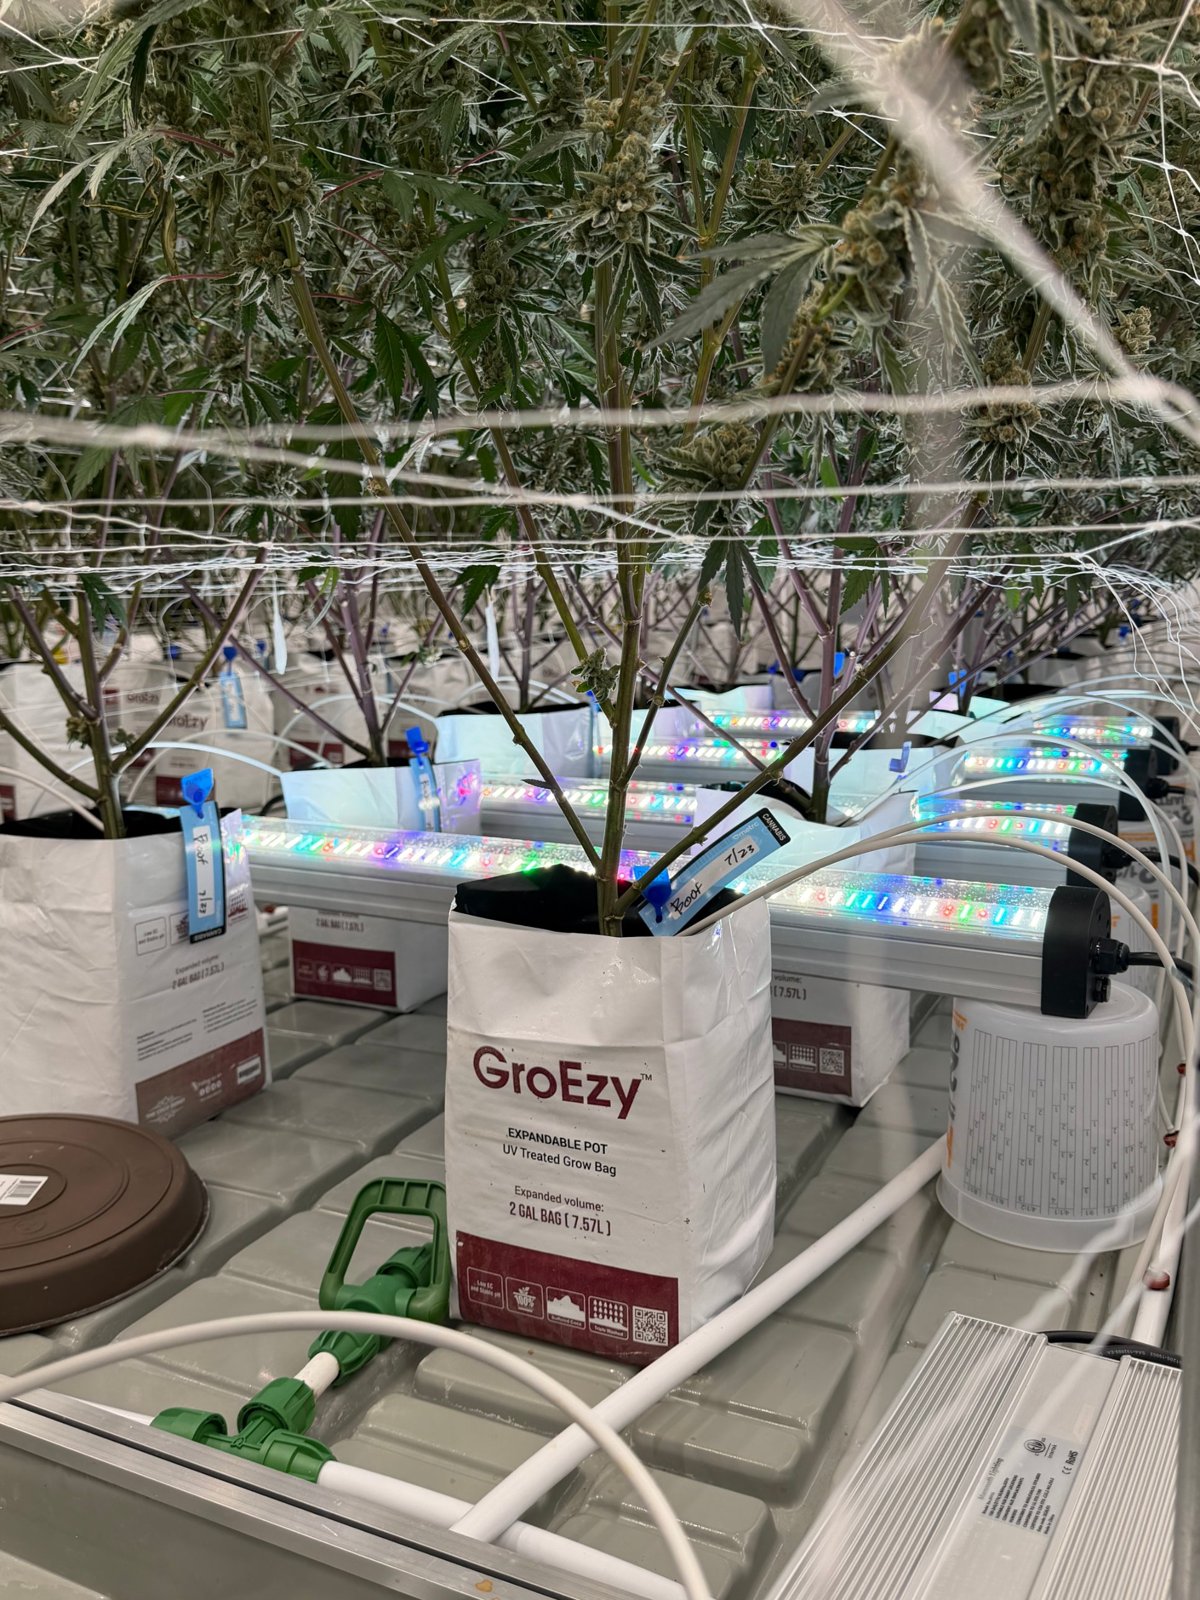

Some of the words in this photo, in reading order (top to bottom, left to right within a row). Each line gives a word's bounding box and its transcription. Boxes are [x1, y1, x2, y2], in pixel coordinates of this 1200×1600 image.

[762, 813, 786, 841] CANNABIS
[724, 844, 755, 866] 7/23
[508, 1127, 582, 1151] EXPANDABLE
[584, 1141, 608, 1155] POT
[502, 1143, 518, 1156] UV
[520, 1147, 560, 1165] Treated
[563, 1155, 592, 1171] Grow
[594, 1161, 617, 1178] Bag
[514, 1185, 562, 1204] Expanded
[564, 1197, 605, 1213] volume:
[509, 1201, 517, 1216] 2
[518, 1203, 539, 1222] GAL
[540, 1208, 562, 1226] BAG
[572, 1214, 604, 1235] 7.57L
[1065, 1450, 1079, 1465] RoHS
